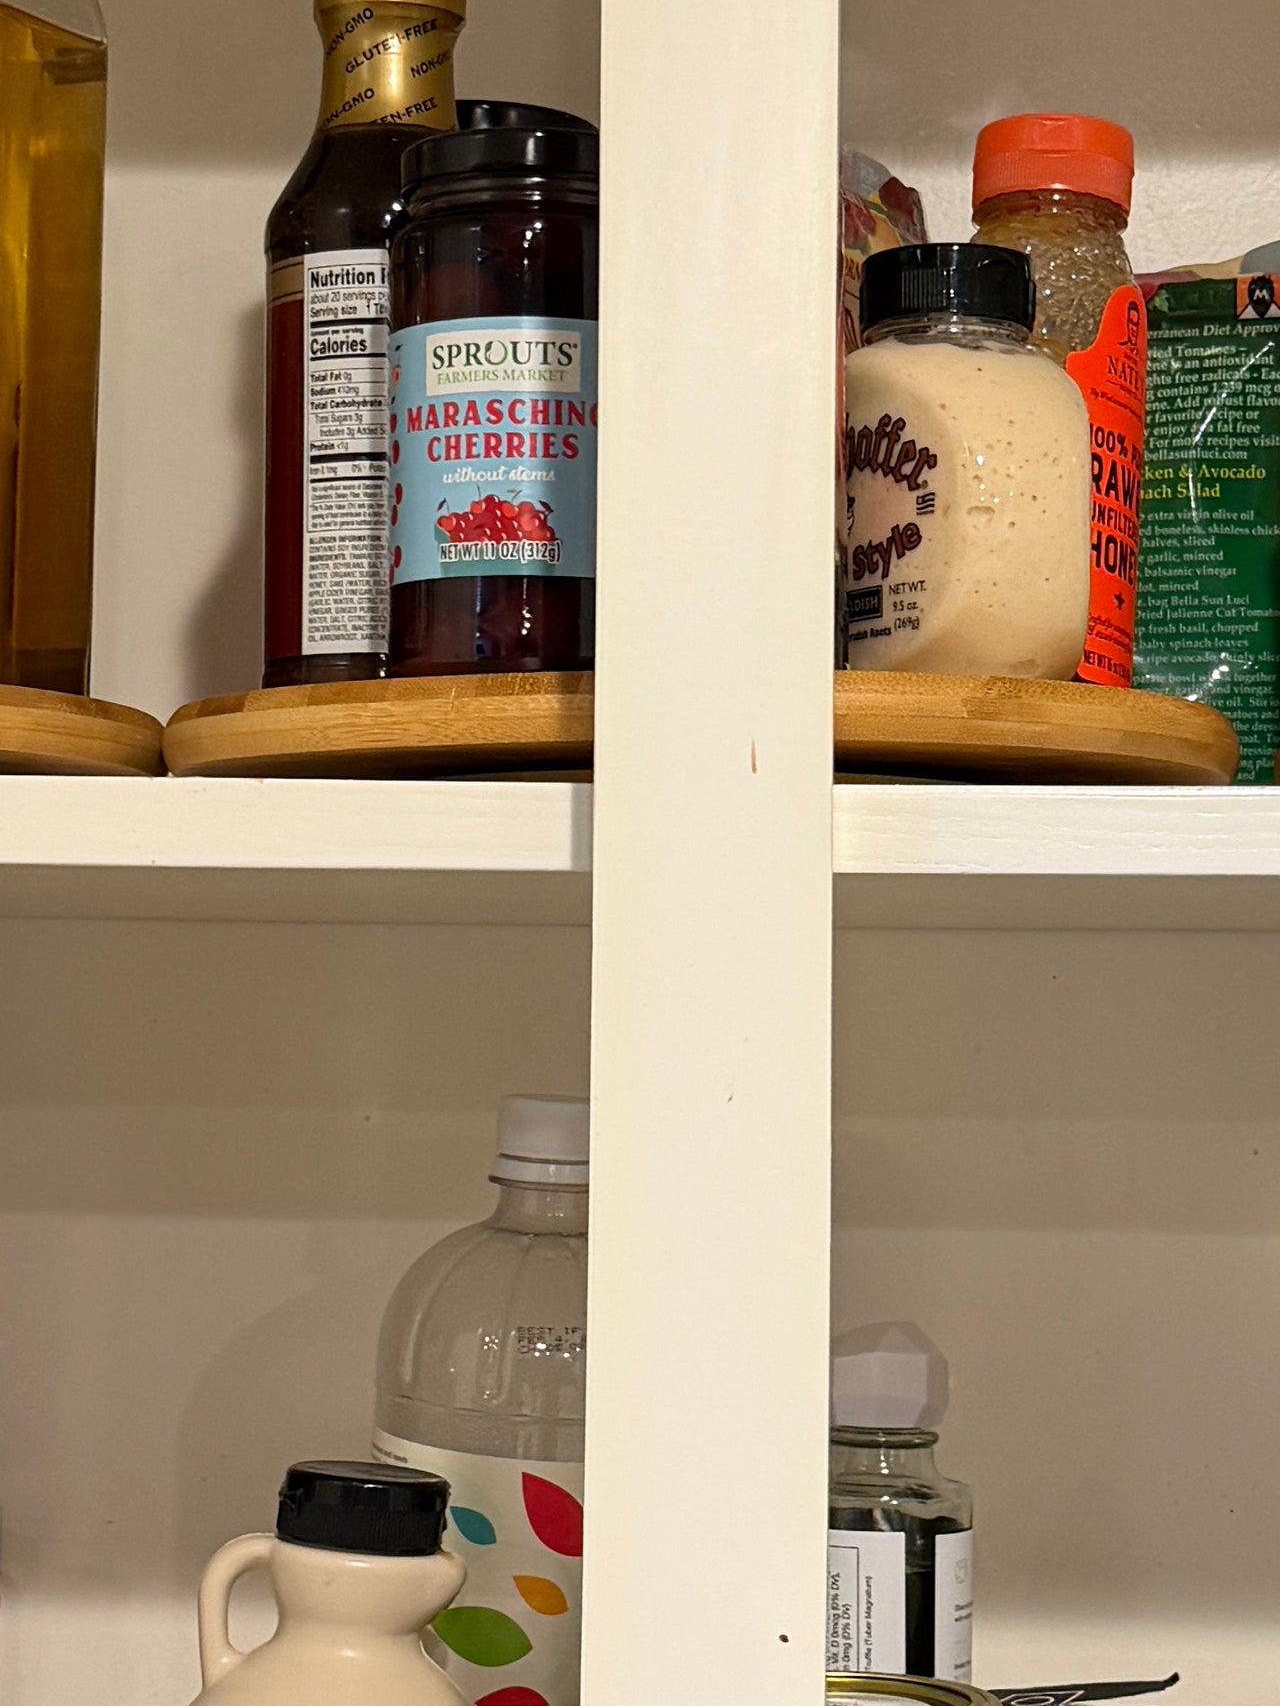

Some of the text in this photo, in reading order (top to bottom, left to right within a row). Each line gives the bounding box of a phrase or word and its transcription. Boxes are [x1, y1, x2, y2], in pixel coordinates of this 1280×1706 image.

[311, 270, 375, 288] Nutrition
[311, 305, 357, 318] Serving size
[1203, 325, 1230, 336] Diet
[311, 337, 367, 355] Calories
[1176, 345, 1236, 357] Tomatoes
[432, 340, 575, 370] SPROUTS
[1184, 354, 1273, 368] an antioxidant
[437, 369, 567, 385] FARMERS MARKET
[1175, 371, 1199, 383] free
[1202, 369, 1250, 381] radicals
[1157, 384, 1208, 397] contains
[1246, 382, 1271, 396] mcg
[1175, 398, 1200, 408] Add
[1153, 421, 1261, 436] enjoy fat free
[426, 432, 579, 463] CHERRIES
[1150, 438, 1170, 448] For
[1207, 436, 1250, 448] recipes
[443, 467, 555, 484] without stems
[1198, 465, 1266, 479] Avocado
[1177, 483, 1220, 497] Slad
[1212, 510, 1254, 521] olive oil
[440, 541, 561, 562] NET WT 11 OZ (312g)
[1091, 531, 1135, 588] HONE
[893, 601, 918, 611] 9.5 oz.
[1171, 595, 1249, 606] Bella Sun Luci
[894, 616, 920, 630] (269g)
[518, 1327, 577, 1335] BEST IF
